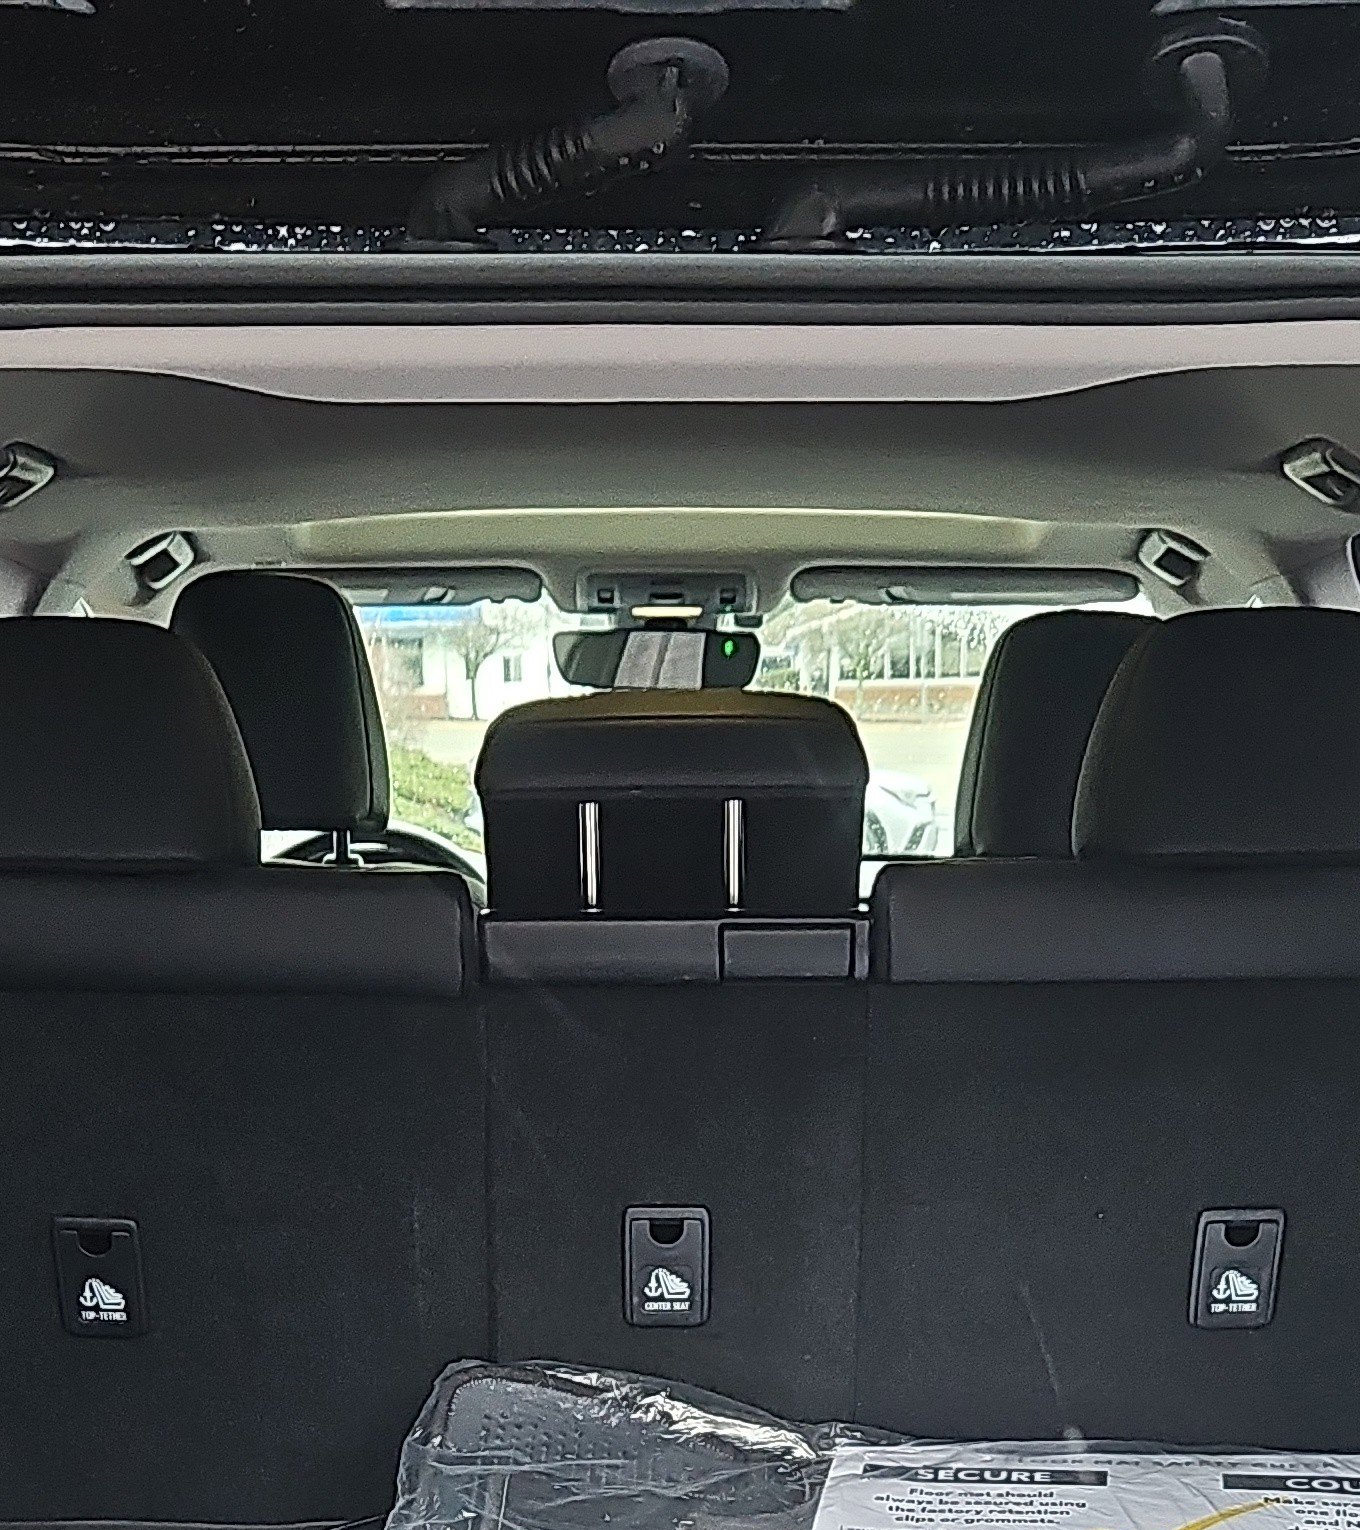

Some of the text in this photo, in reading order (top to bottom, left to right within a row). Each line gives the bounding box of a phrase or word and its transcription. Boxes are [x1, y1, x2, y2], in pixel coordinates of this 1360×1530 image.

[644, 1301, 691, 1311] CENTER SEAT
[915, 1468, 1053, 1483] SECURE
[908, 1487, 1055, 1499] Floor mat should
[873, 1494, 1087, 1508] always be secured using
[1263, 1496, 1317, 1506] Make
[888, 1505, 1071, 1516] the factory retention
[1294, 1507, 1328, 1517] one
[894, 1514, 936, 1524] clips
[1303, 1518, 1341, 1528] and
